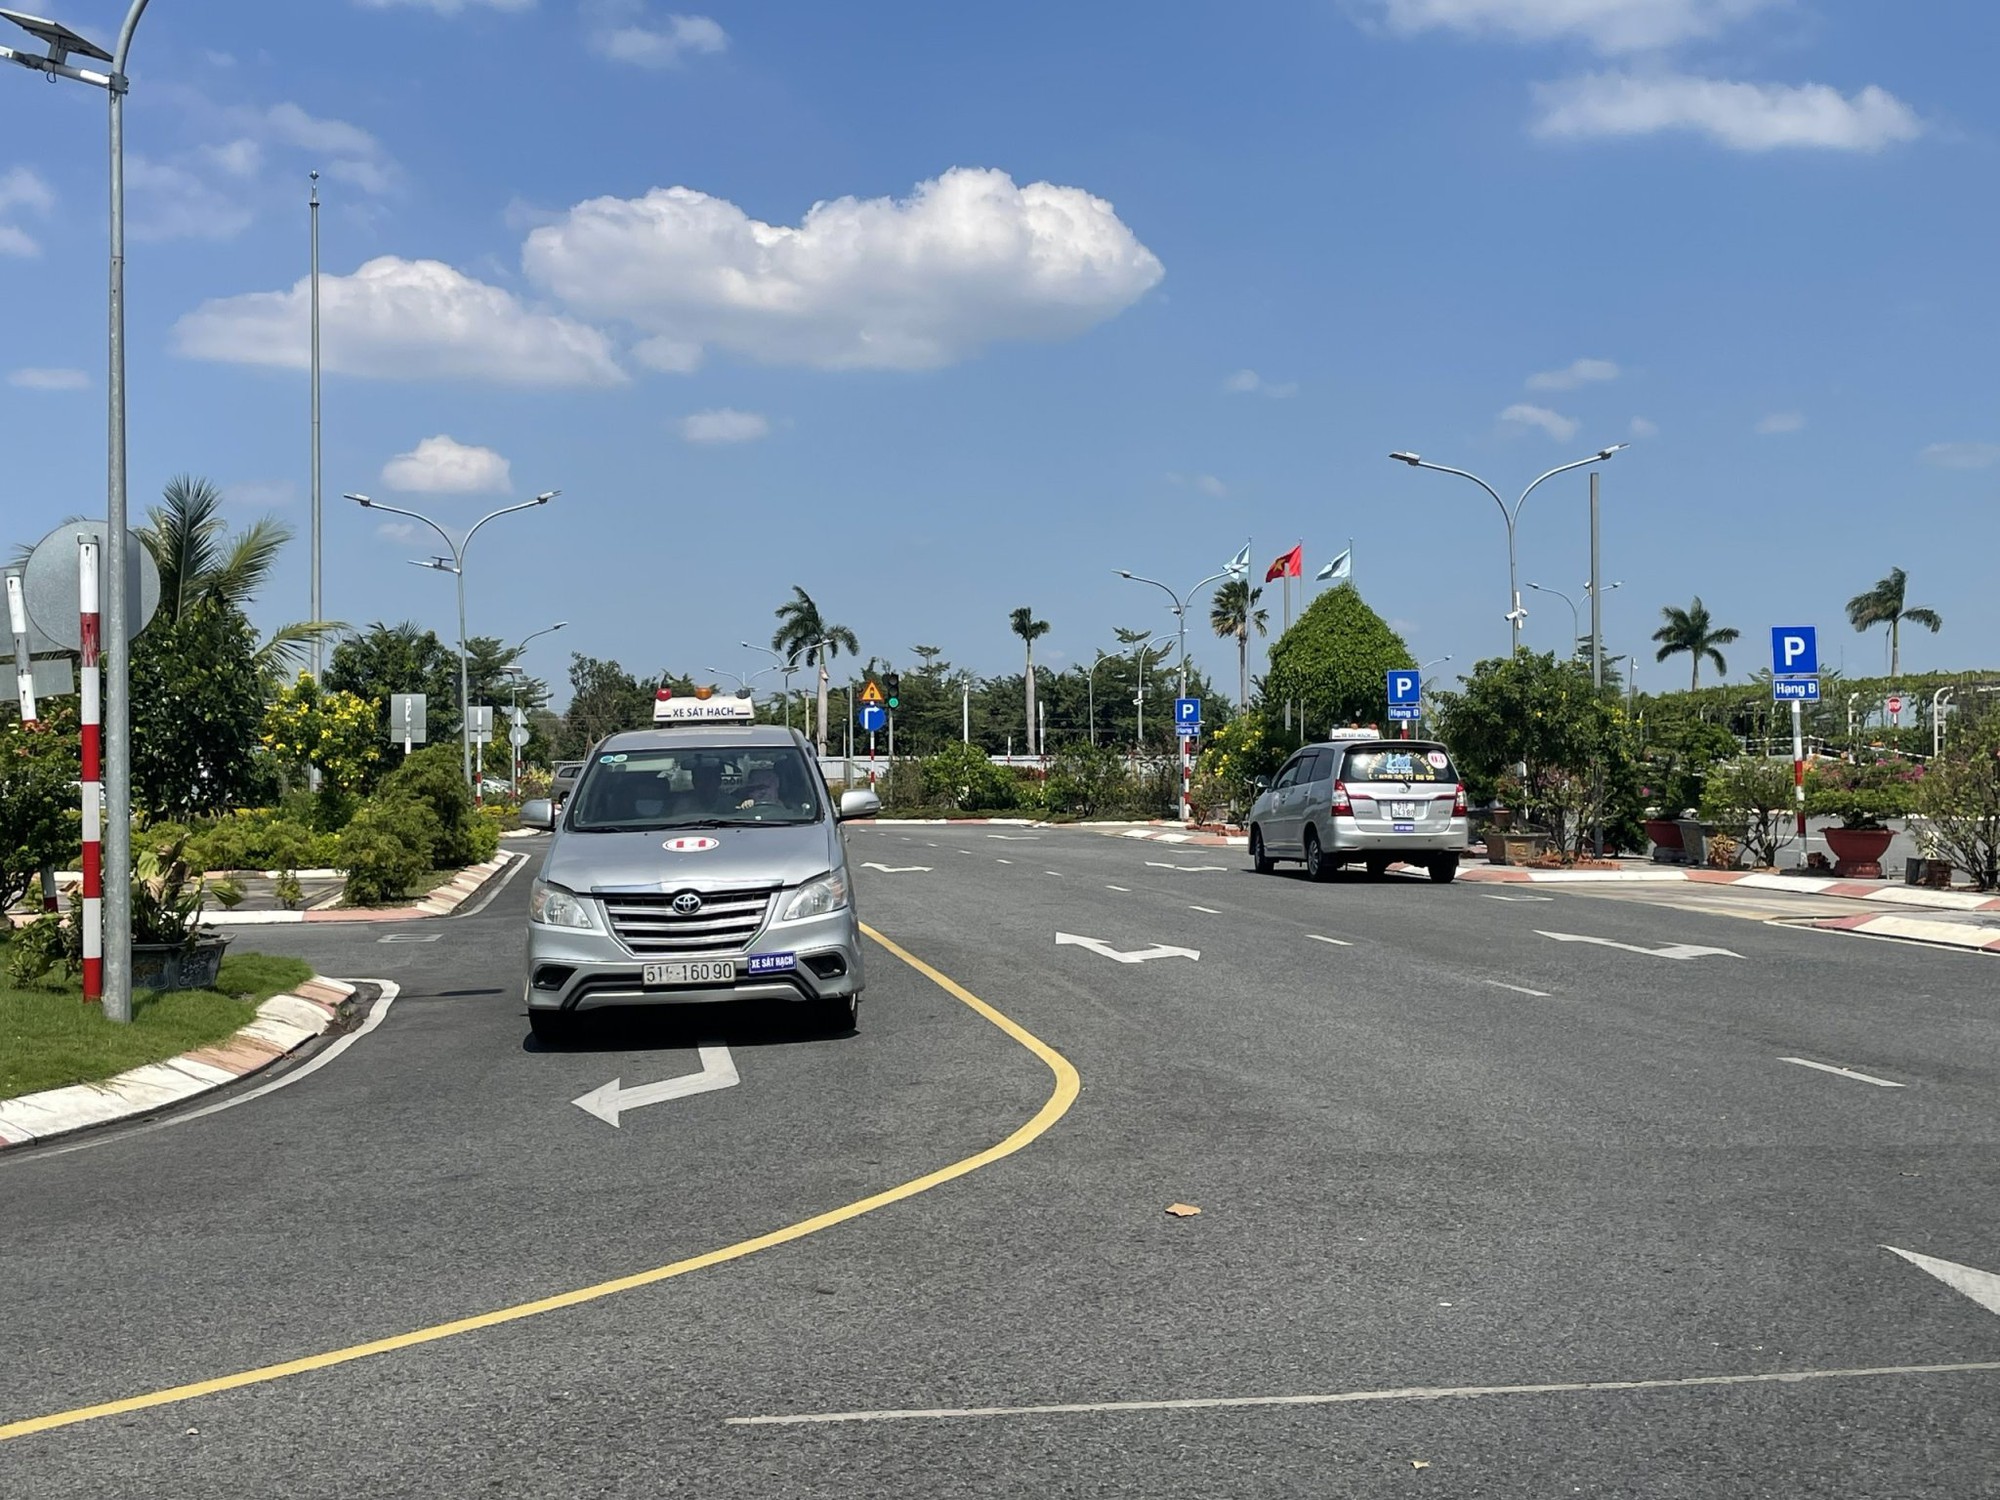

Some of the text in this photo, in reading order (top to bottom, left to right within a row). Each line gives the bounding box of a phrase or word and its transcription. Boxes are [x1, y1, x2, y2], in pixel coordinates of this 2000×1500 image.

[1784, 636, 1805, 666] P
[1397, 678, 1412, 698] P
[1776, 682, 1816, 697] Hạng B
[673, 706, 734, 718] XE SÁT HẠCH
[1182, 704, 1194, 719] P
[1390, 708, 1411, 718] Hạng
[751, 955, 794, 969] XE SÁT HẠCH
